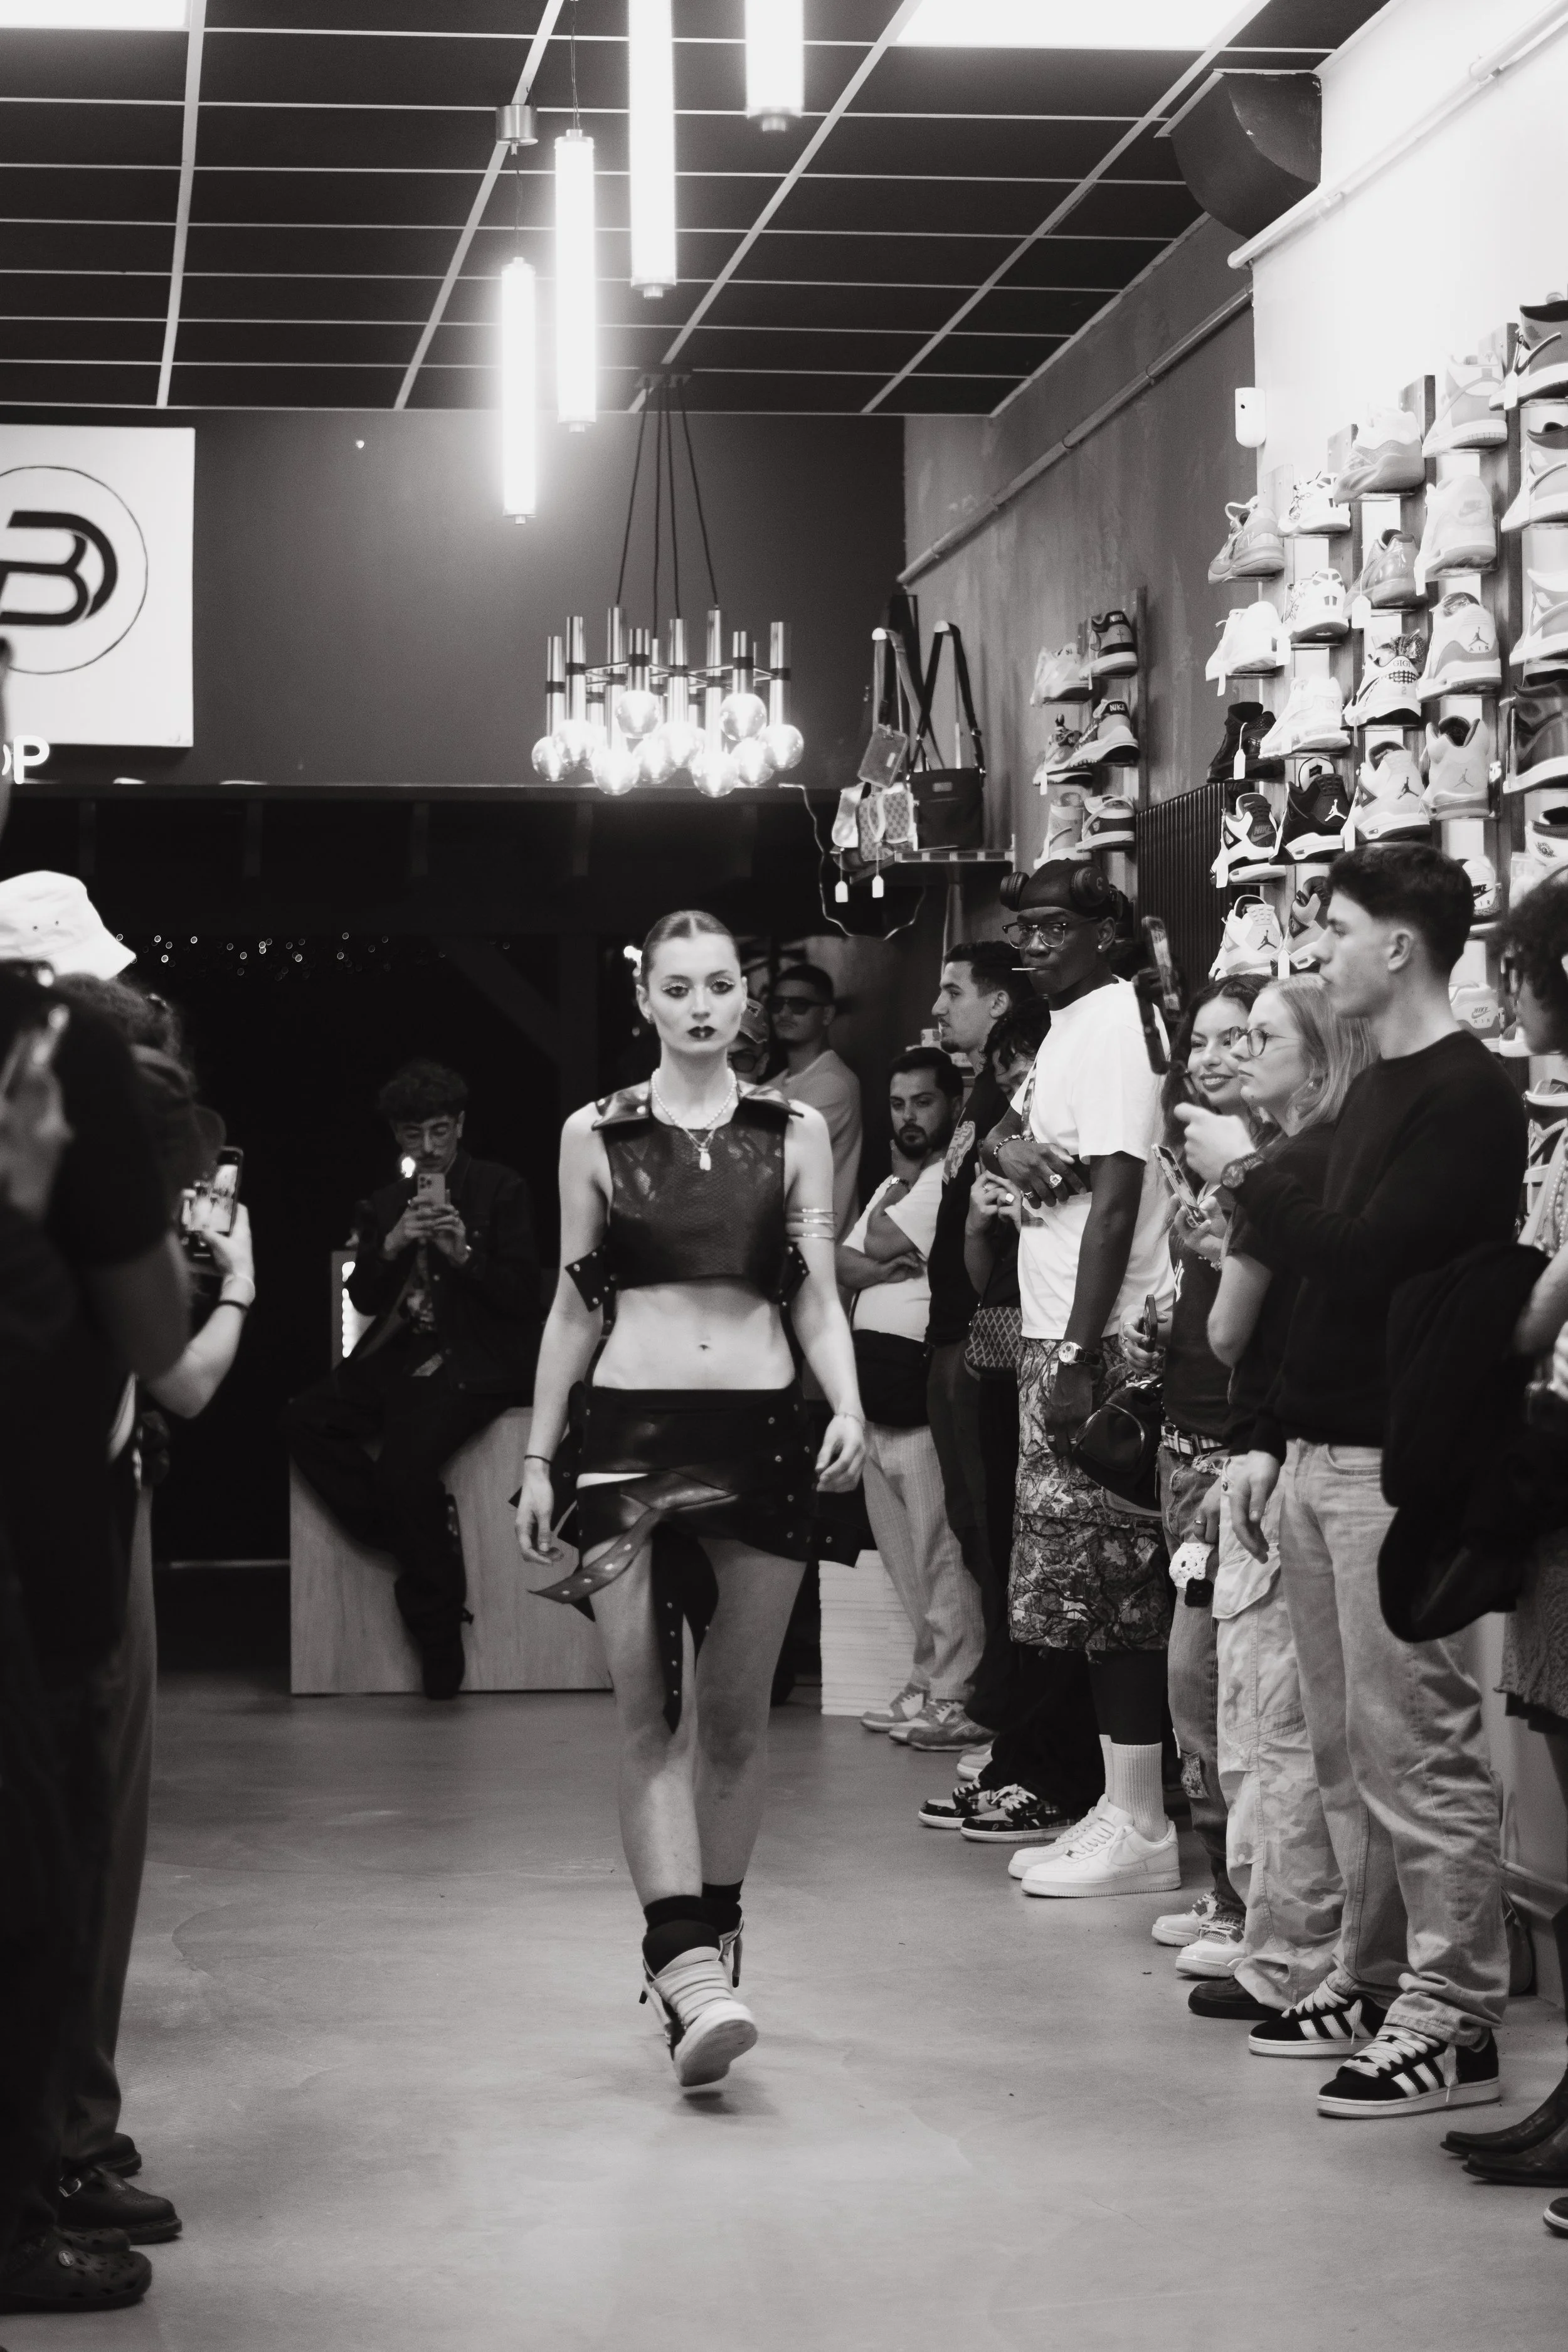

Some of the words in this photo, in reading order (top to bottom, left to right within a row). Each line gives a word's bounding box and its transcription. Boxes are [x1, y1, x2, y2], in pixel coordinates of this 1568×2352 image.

[1109, 614, 1124, 623] NIKE
[1393, 660, 1411, 668] GIGI
[1110, 703, 1126, 712] NIKE
[1254, 825, 1272, 836] NIKE
